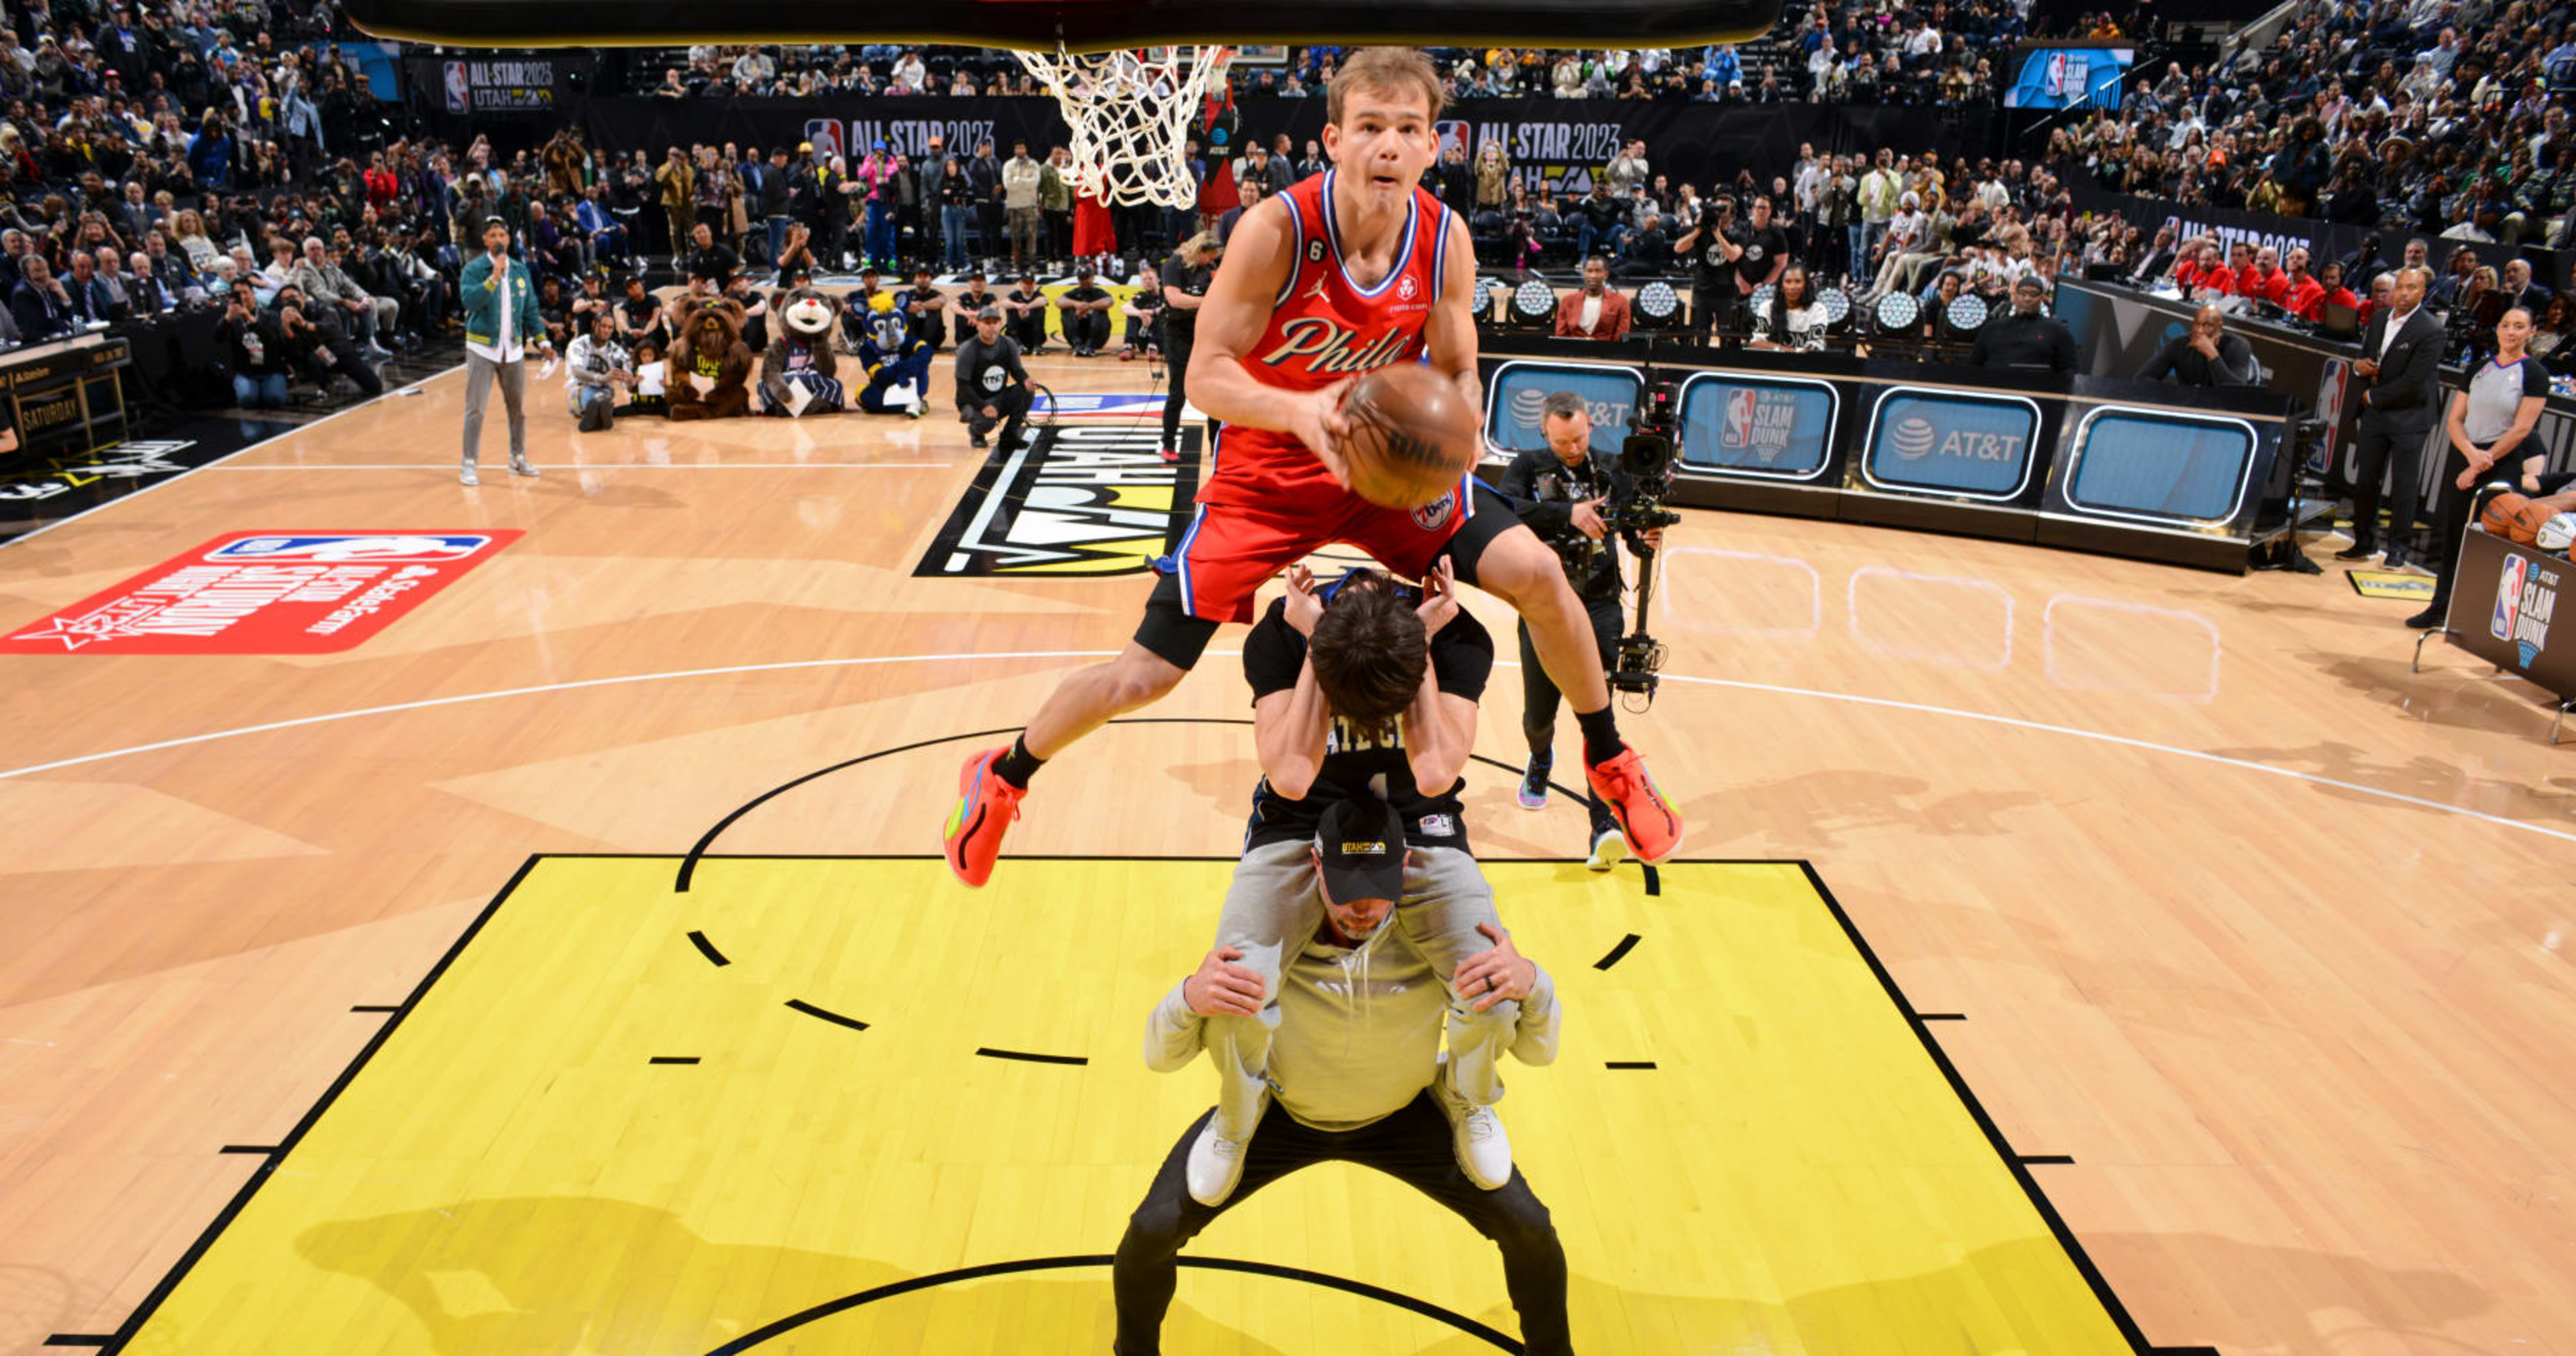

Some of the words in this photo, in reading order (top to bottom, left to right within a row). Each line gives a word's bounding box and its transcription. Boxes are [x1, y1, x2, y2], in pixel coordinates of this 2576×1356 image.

[475, 89, 511, 105] UTAH
[1573, 123, 1622, 160] 2023
[1309, 242, 1324, 260] 6
[22, 399, 77, 431] SATURDAY
[1754, 404, 1794, 428] SLAM
[1750, 427, 1789, 447] DUNK
[1939, 430, 2021, 462] AT&T
[1034, 427, 1184, 484] UTAH
[132, 565, 243, 599] NIGHT
[2539, 570, 2560, 586] AT&T
[136, 565, 329, 636] SATURDAY
[2520, 583, 2556, 624] SLAM
[2514, 614, 2549, 652] DUNK
[1342, 841, 1363, 853] UTAH
